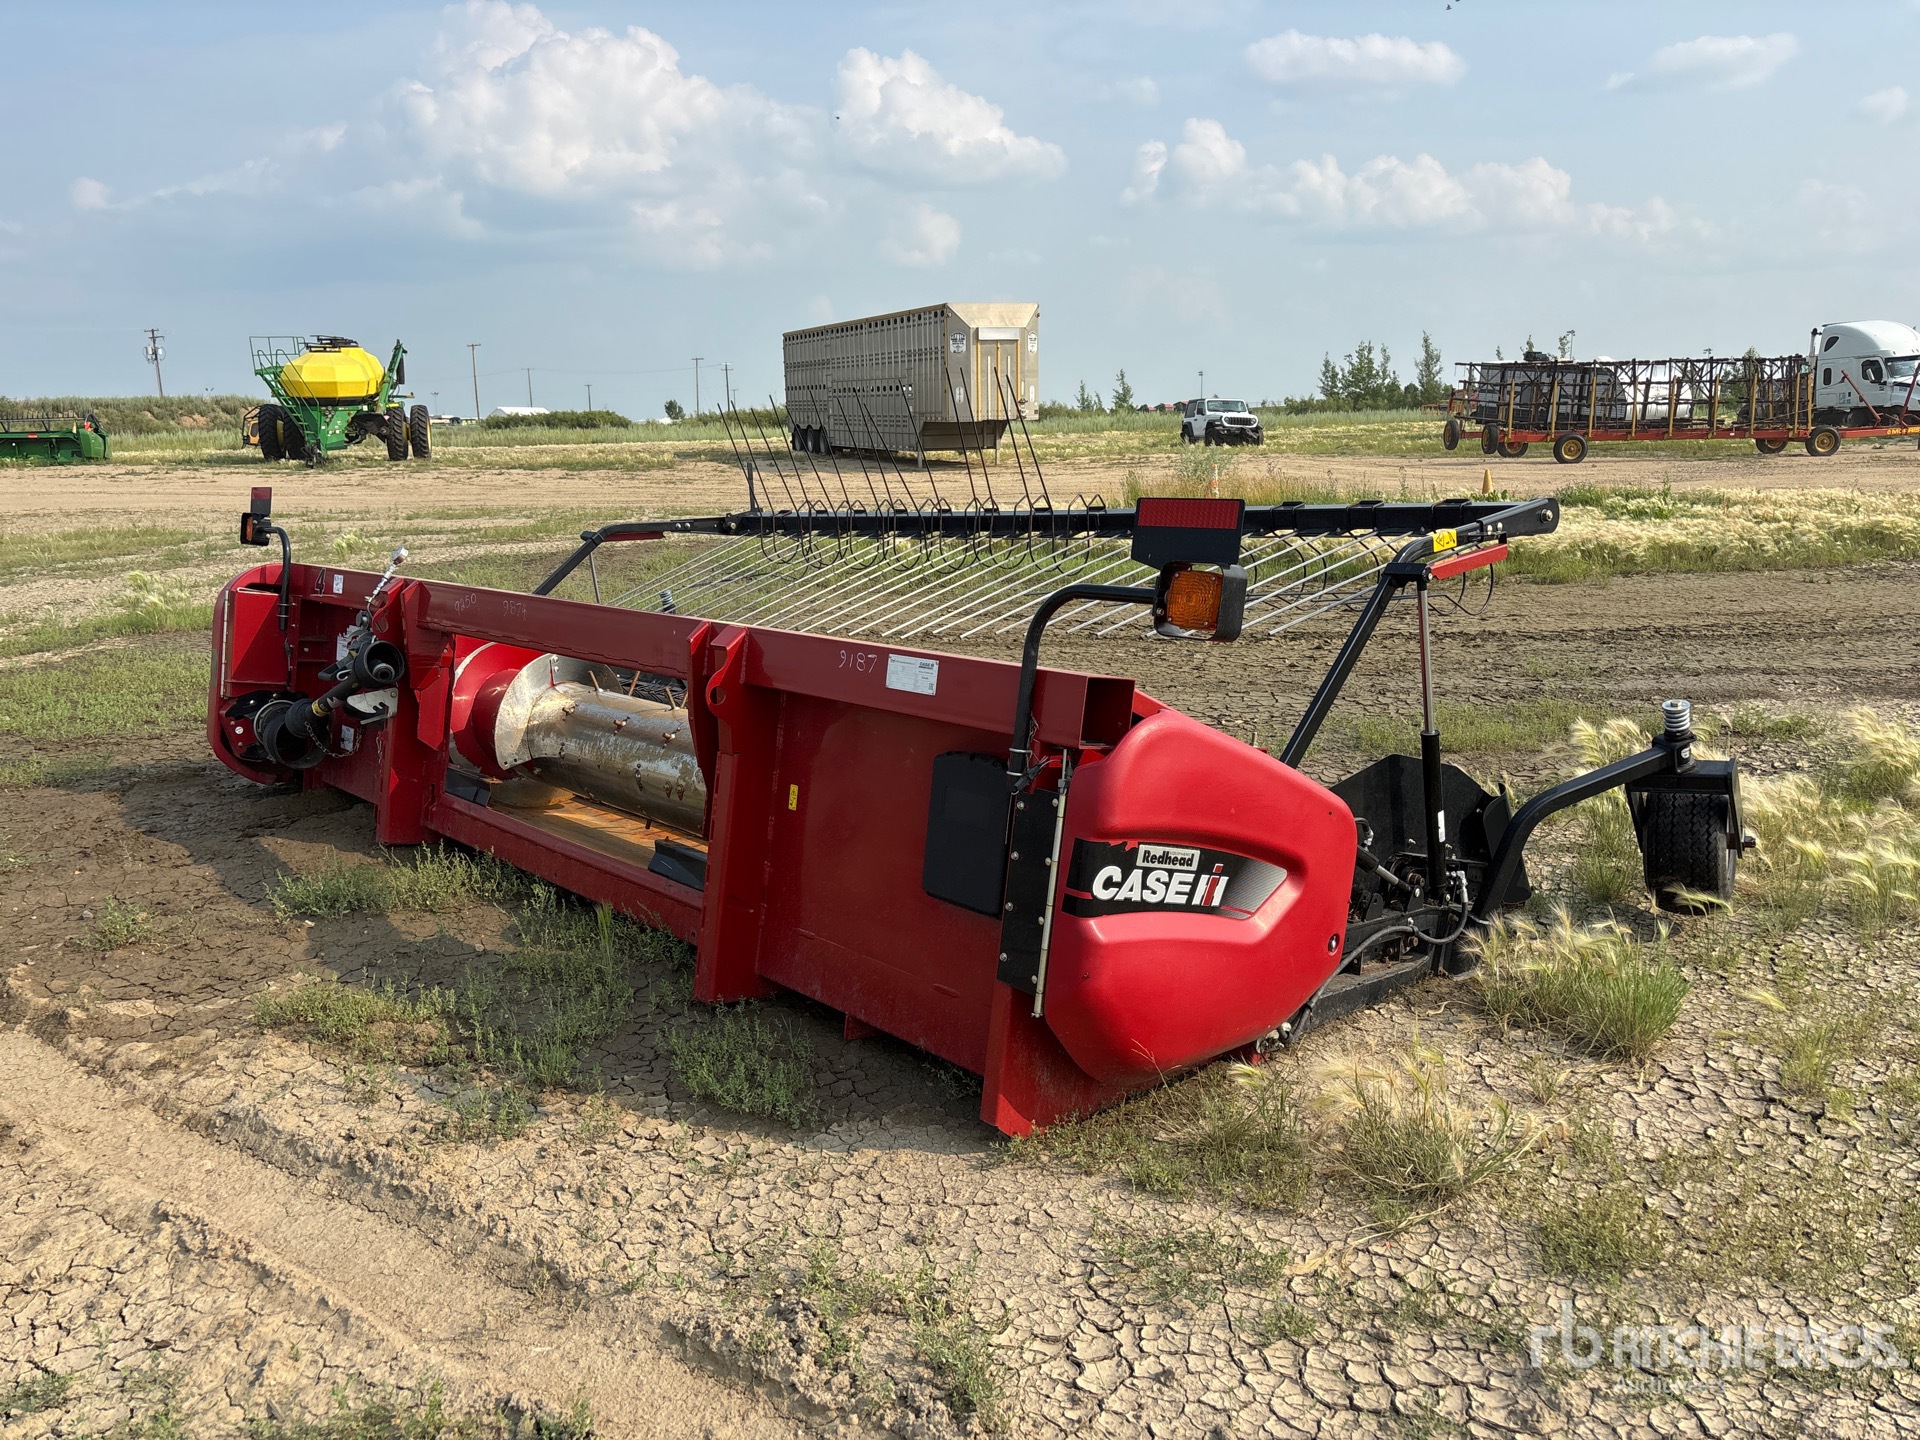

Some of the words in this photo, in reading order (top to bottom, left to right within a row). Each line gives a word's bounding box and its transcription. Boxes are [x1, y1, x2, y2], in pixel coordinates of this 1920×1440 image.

[839, 650, 877, 673] 9187
[1142, 850, 1194, 867] Redhead
[1092, 865, 1195, 904] CASE
